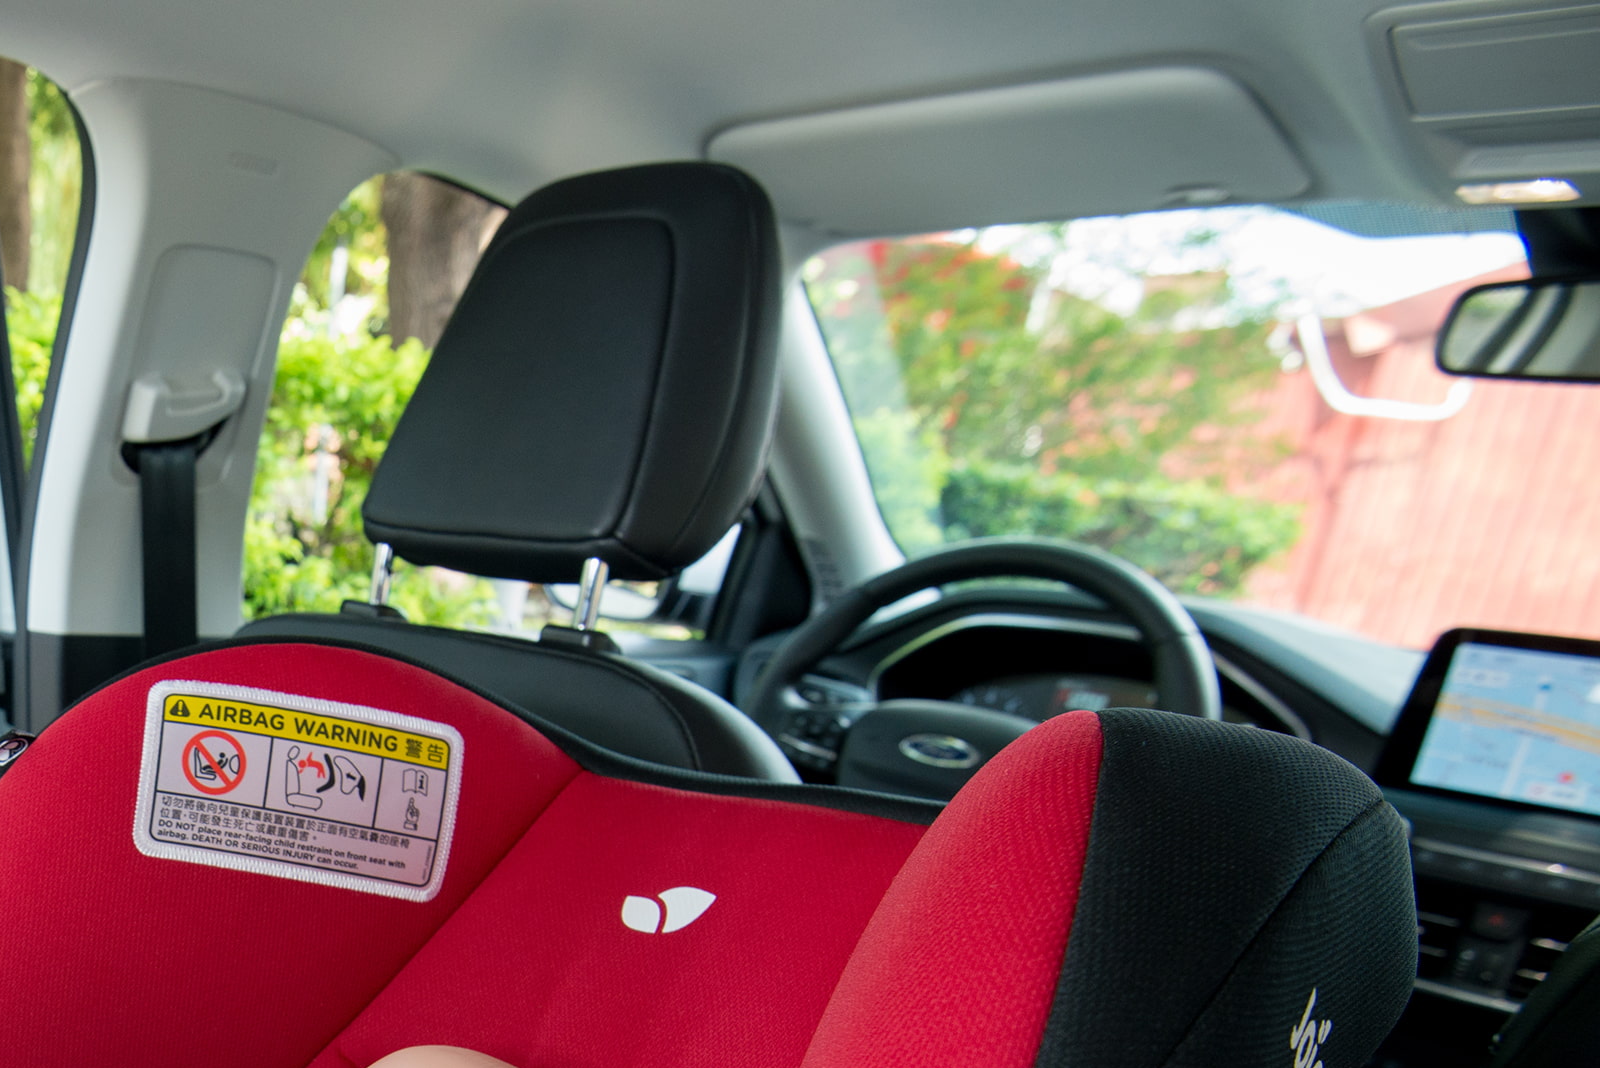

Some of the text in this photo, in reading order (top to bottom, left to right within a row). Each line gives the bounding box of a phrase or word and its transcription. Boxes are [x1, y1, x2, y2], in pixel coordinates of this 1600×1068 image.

[199, 703, 444, 763] AIRBAG WARNING 警告
[157, 828, 359, 870] airbag. DEATH OR SERIOUS INJURY can occur.
[158, 819, 406, 868] DO NOT place rear-facing child restraint on front seat with
